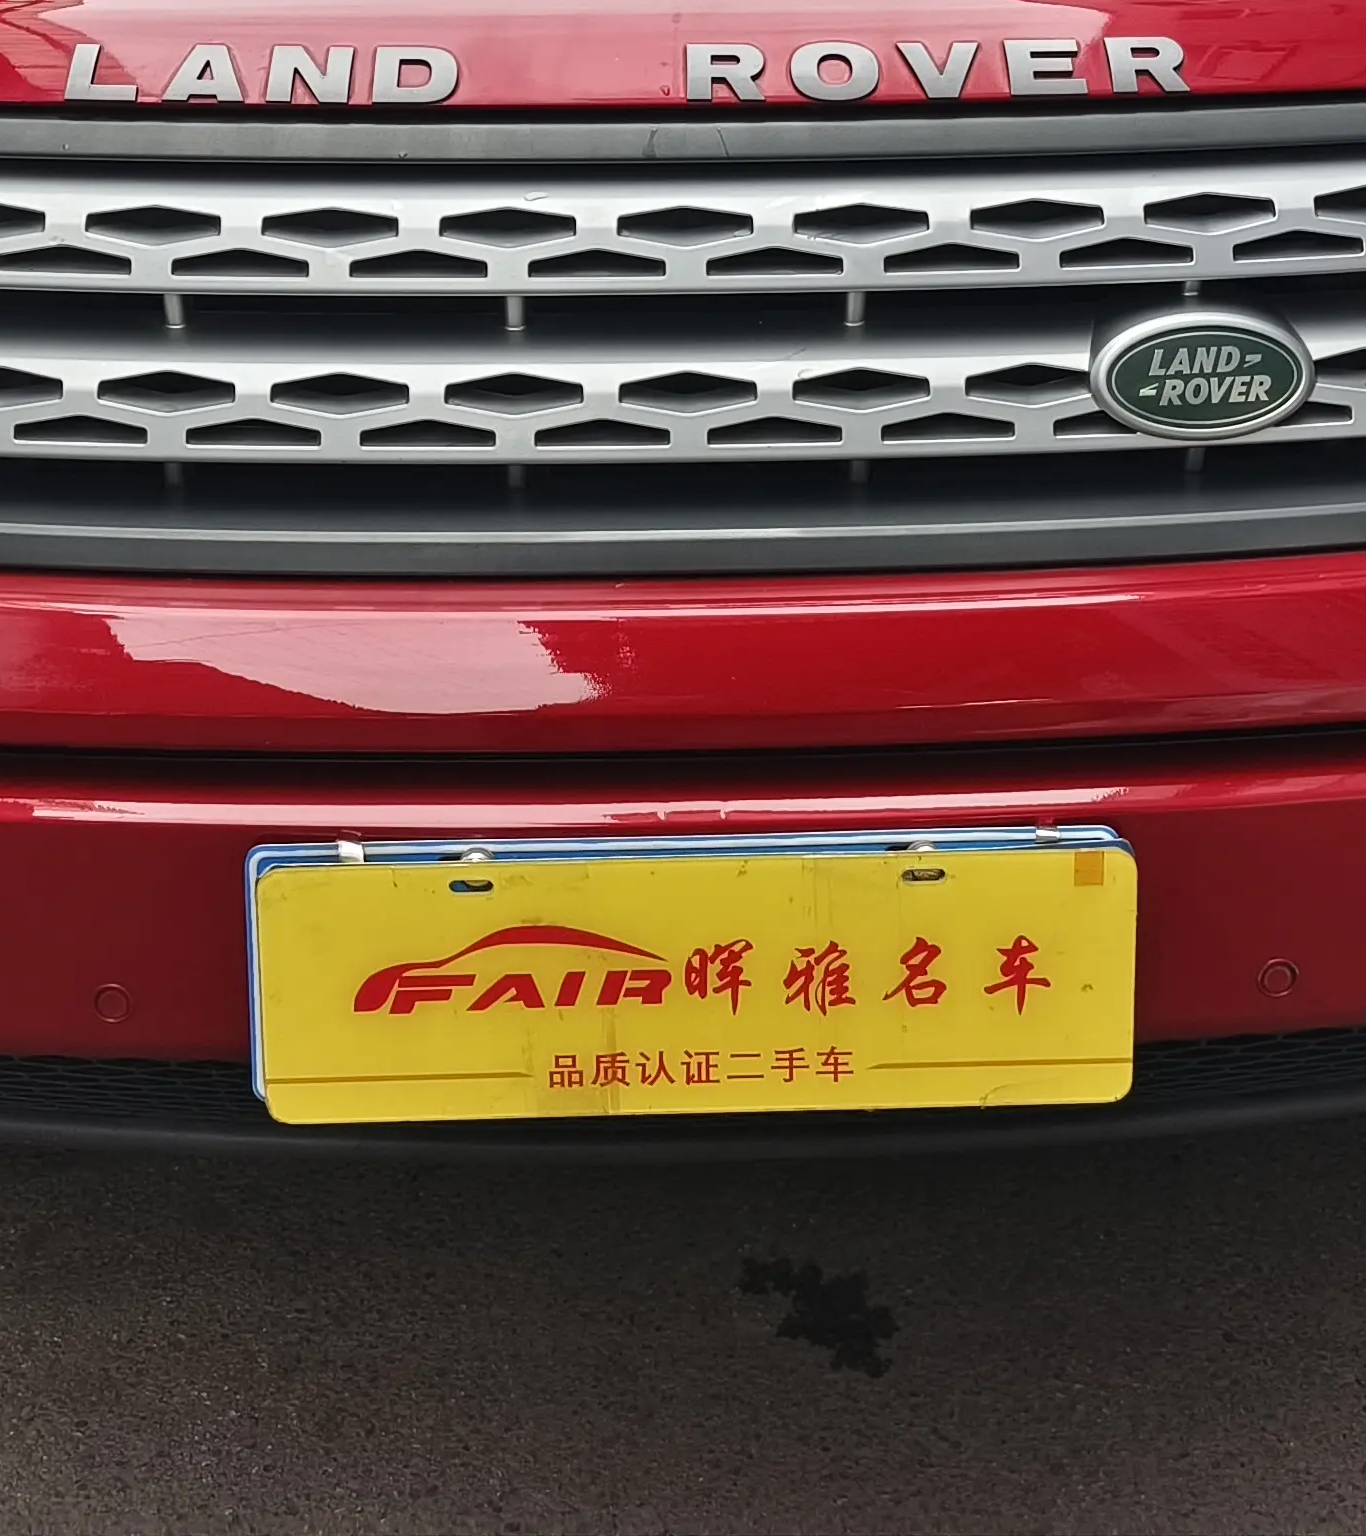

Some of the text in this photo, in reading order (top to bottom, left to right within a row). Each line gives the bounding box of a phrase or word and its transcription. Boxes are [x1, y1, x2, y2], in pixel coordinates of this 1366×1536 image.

[63, 35, 1191, 106] LAND ROVER
[1148, 345, 1241, 376] LAND
[1158, 375, 1273, 407] ROVER
[355, 934, 1051, 1016] FAIR 晖雅名车
[548, 1046, 854, 1089] 品质认证二手车
